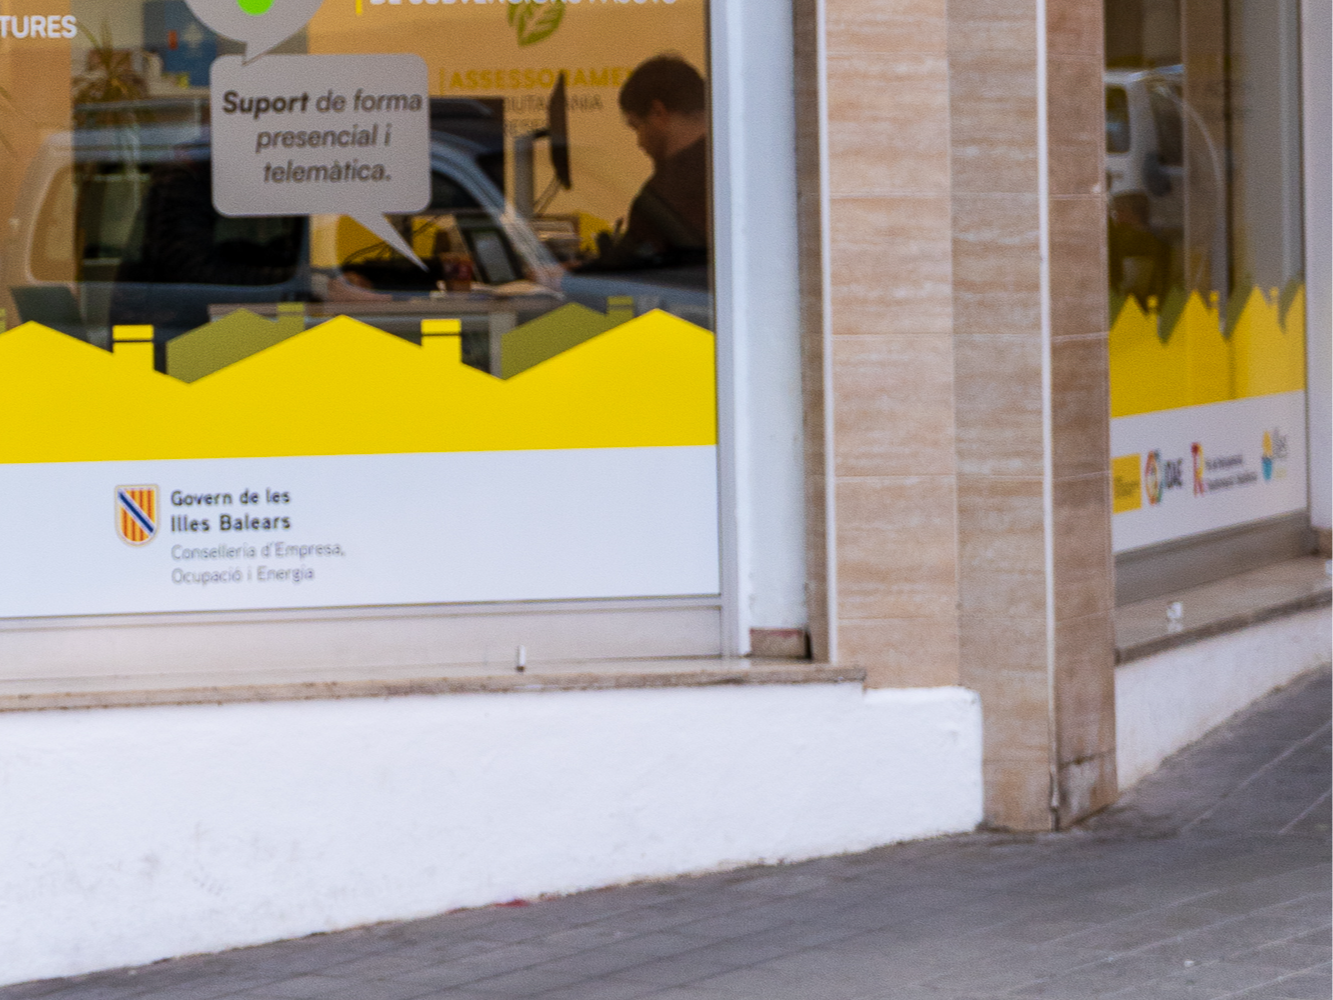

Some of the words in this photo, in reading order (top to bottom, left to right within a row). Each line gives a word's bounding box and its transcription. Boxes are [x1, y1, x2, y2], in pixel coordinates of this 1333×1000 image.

[222, 90, 310, 120] Suport
[316, 88, 346, 113] de
[353, 88, 423, 112] forma
[255, 123, 378, 153] presencial
[384, 123, 392, 147] i
[263, 158, 392, 183] telemàtica.
[170, 490, 233, 506] Govern
[239, 488, 260, 505] de
[266, 488, 291, 504] les
[170, 514, 210, 532] Illes
[219, 513, 291, 531] Balears
[171, 542, 256, 560] Conselleria
[171, 566, 243, 587] Ocupació
[257, 564, 315, 584] Energia
